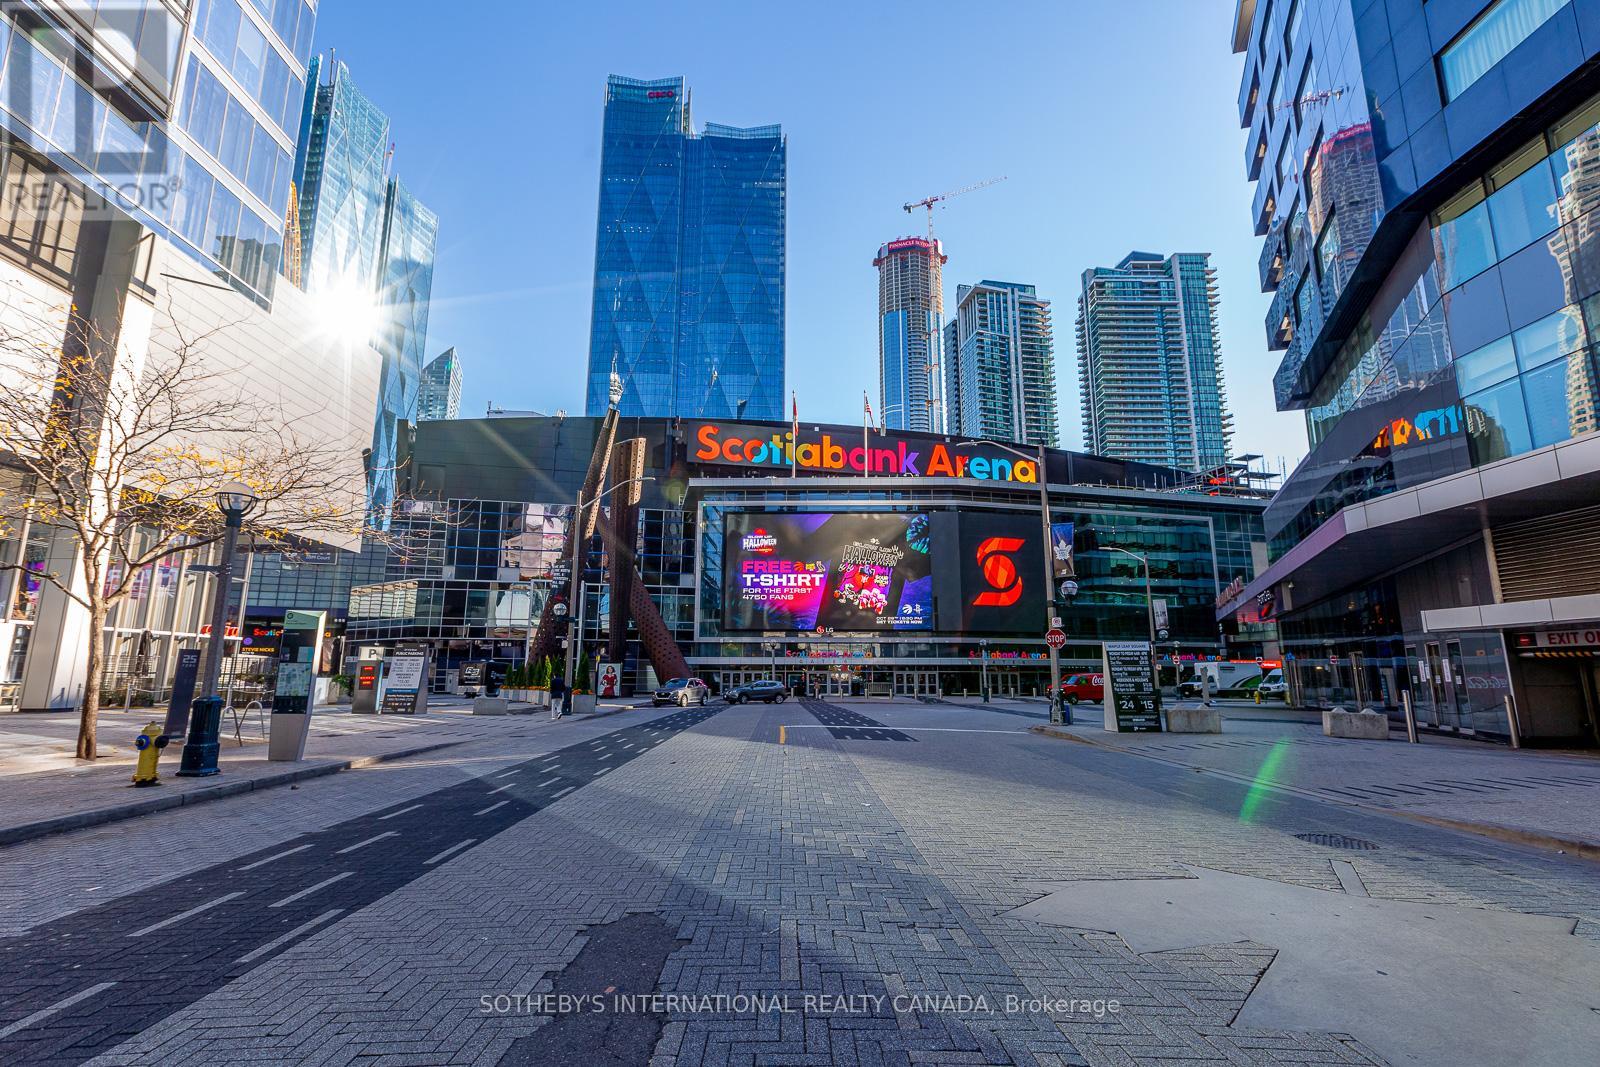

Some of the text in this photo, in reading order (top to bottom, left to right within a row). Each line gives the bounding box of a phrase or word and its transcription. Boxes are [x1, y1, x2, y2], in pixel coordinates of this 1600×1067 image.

[696, 425, 1036, 483] Scotiabank Arena
[743, 538, 777, 549] HALLOWEEN
[843, 545, 898, 566] HALLOWEEN
[742, 560, 792, 573] FREE
[742, 573, 824, 586] T-SHIRT
[1047, 635, 1064, 643] STOP
[1547, 632, 1579, 645] EXIT
[368, 649, 376, 658] P
[786, 649, 873, 658] Scotiabank Arena
[1021, 651, 1047, 659] Arena
[1198, 653, 1222, 661] Arena
[183, 655, 198, 663] 25
[1120, 701, 1134, 709] $24
